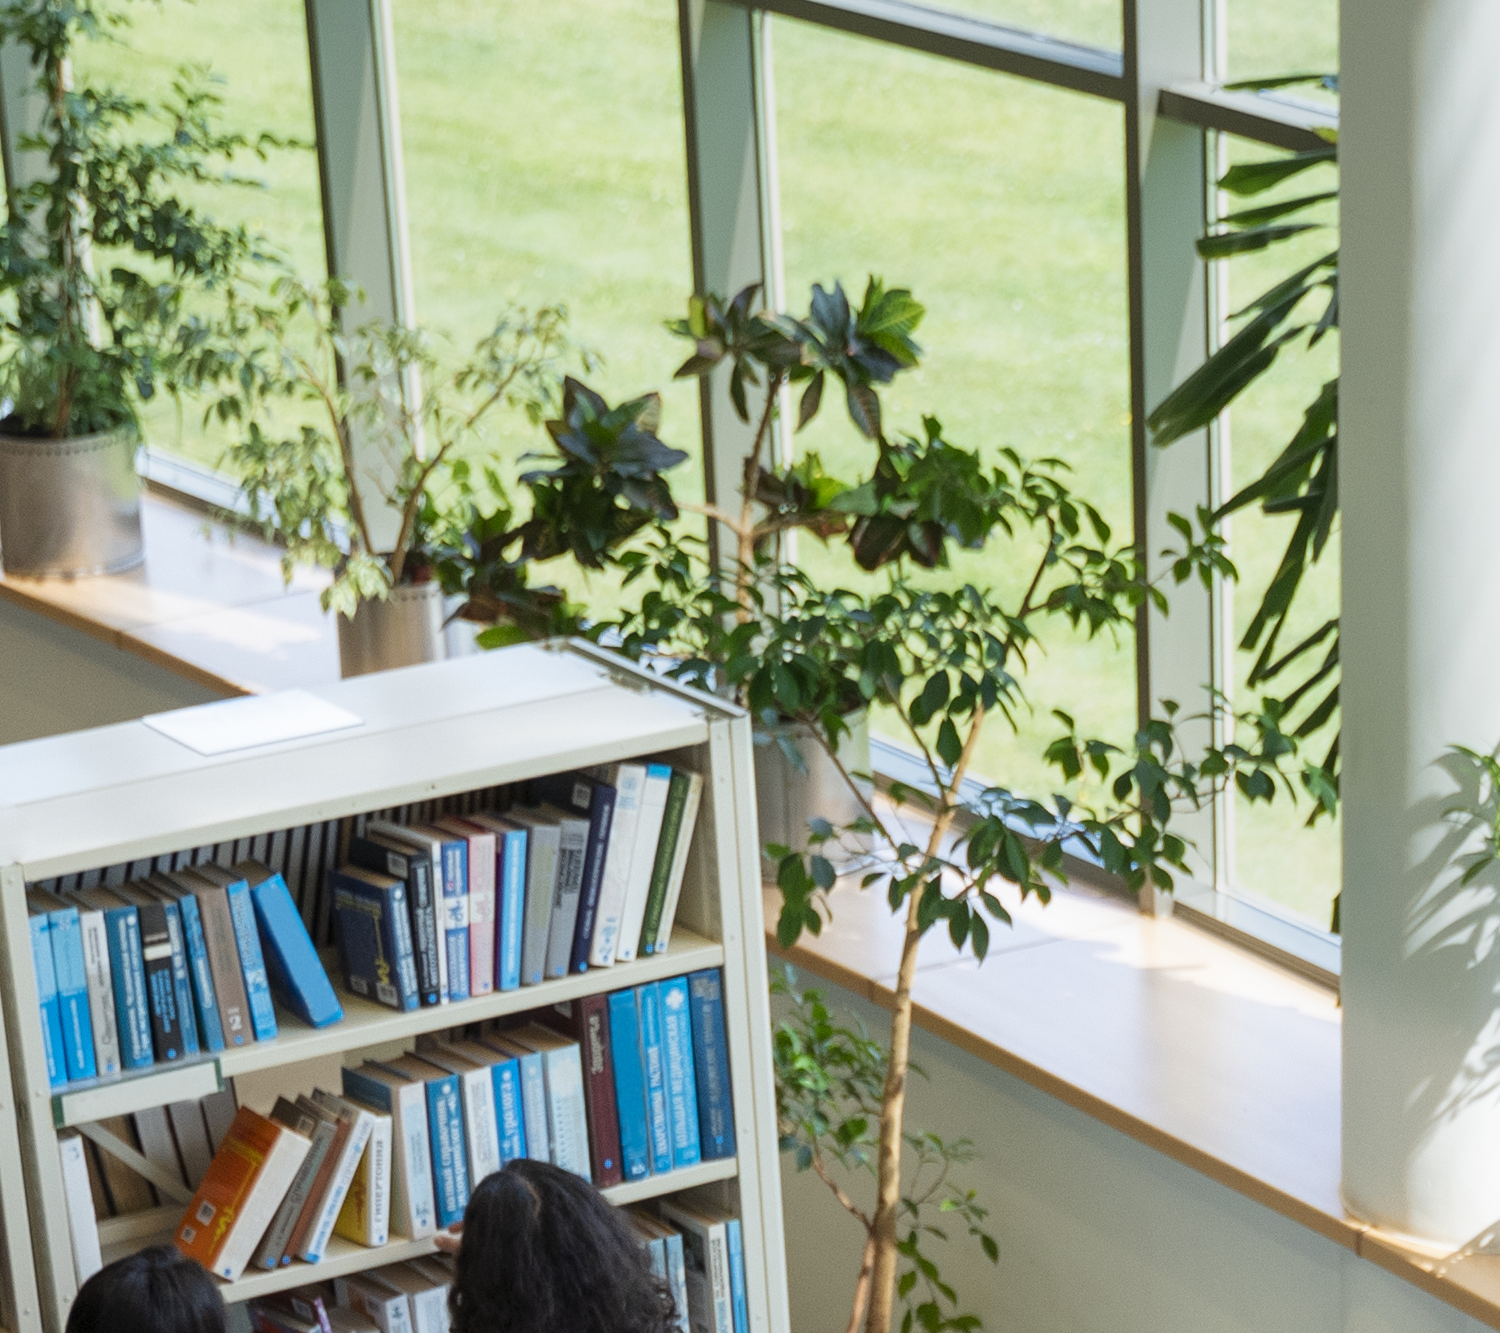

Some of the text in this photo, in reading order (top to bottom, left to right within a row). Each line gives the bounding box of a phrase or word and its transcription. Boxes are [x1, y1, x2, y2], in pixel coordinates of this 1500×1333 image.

[662, 1014, 690, 1148] БОЛЬШАЯ МЕДИЦИНСКАЯ
[373, 1139, 383, 1222] ГИПЕРТОНИЯ
